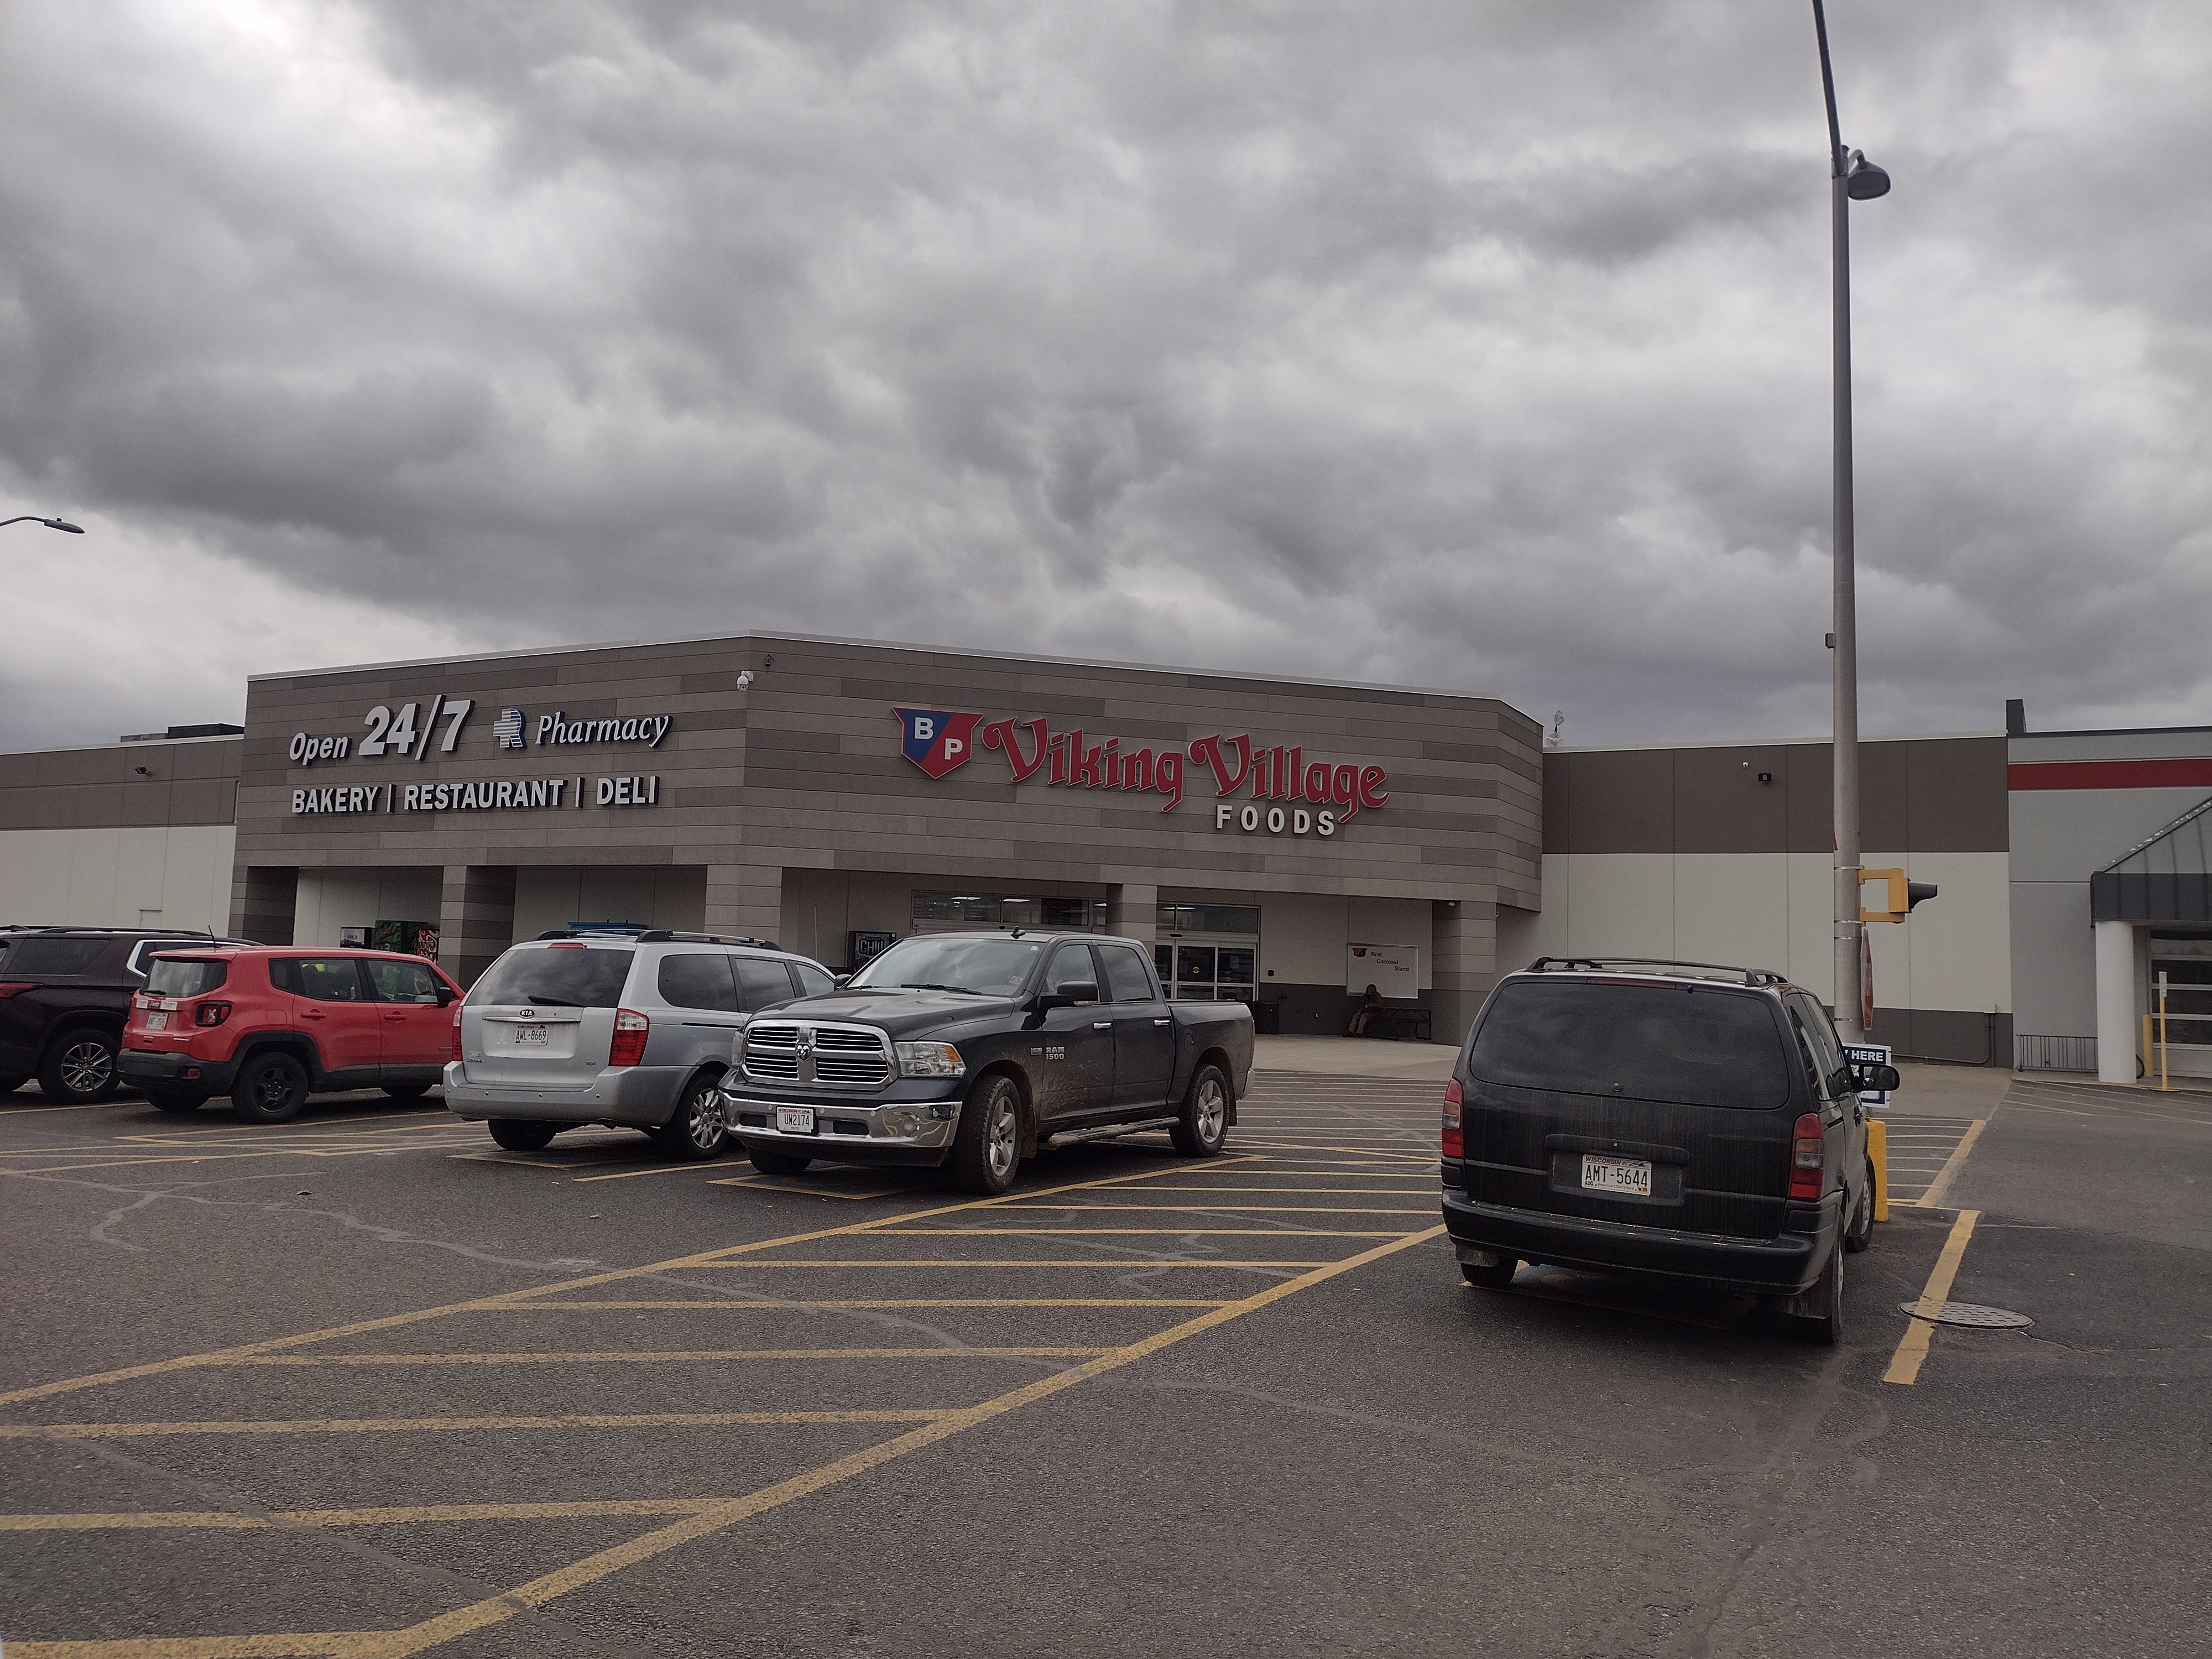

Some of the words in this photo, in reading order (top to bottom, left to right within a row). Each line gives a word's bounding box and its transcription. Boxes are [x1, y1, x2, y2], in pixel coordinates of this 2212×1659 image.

[289, 732, 349, 766] Open
[358, 694, 472, 760] 24/7
[535, 711, 670, 748] Pharmacy
[982, 717, 1184, 813] Viking
[1188, 733, 1390, 823] Village
[291, 786, 379, 813] BAKERY
[404, 779, 565, 810] RESTAURANT
[596, 776, 656, 805] DELI
[1216, 805, 1335, 836] FOODS
[516, 1030, 546, 1040] AWL-8669
[1851, 1050, 1884, 1062] HERE
[784, 1113, 810, 1126] UW2174
[1585, 1156, 1621, 1165] WISCONSIN
[1585, 1164, 1648, 1187] AMT-5644
